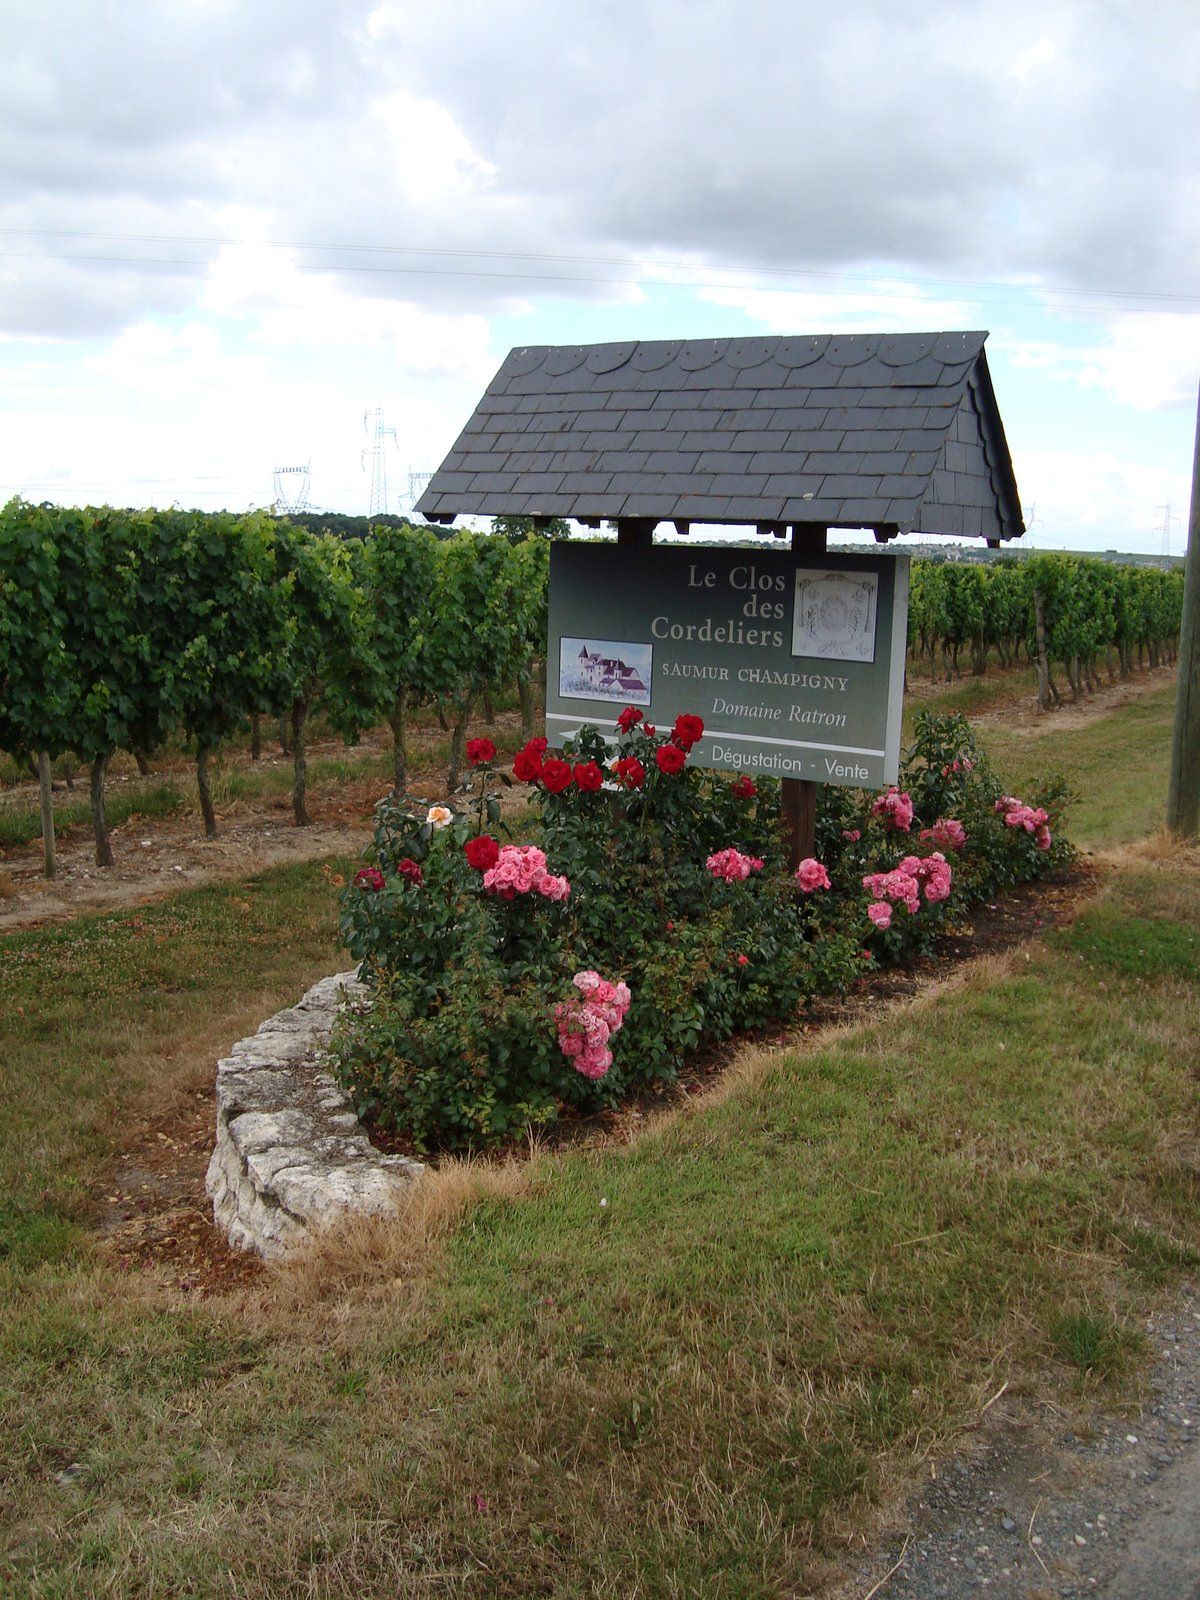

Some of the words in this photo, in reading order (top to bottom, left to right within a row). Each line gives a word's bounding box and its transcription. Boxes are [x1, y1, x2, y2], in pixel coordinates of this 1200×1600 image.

[688, 564, 717, 588] Le
[729, 566, 786, 592] Clos
[742, 594, 785, 618] des
[651, 616, 784, 647] Cordeliers
[662, 662, 729, 681] SAUMUR
[738, 667, 849, 692] CHAMPIGNY
[712, 698, 782, 720] Domaine
[789, 704, 847, 727] Ratron
[712, 745, 801, 771] Dégustation
[824, 758, 870, 780] Vente
